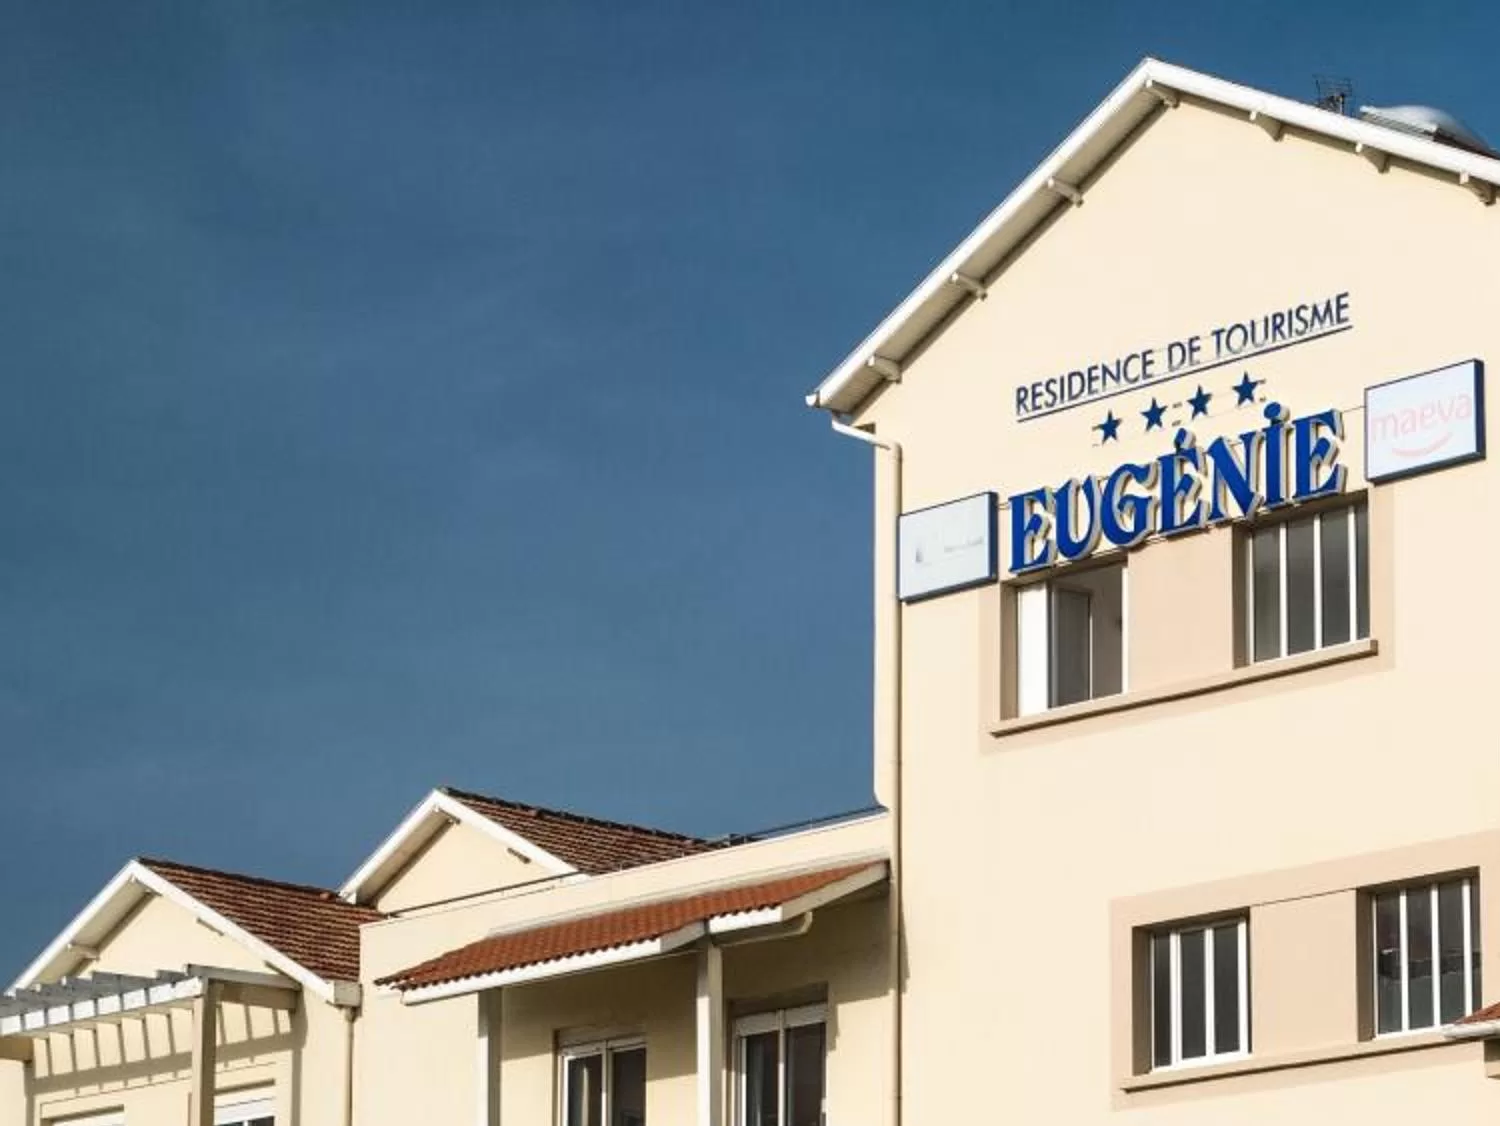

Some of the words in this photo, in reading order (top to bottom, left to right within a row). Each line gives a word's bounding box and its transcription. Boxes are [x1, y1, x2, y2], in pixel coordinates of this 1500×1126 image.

[1016, 349, 1154, 416] RESIDENCE
[1168, 335, 1201, 371] DE
[1211, 292, 1350, 358] TOURISME
[1370, 393, 1473, 442] maeva
